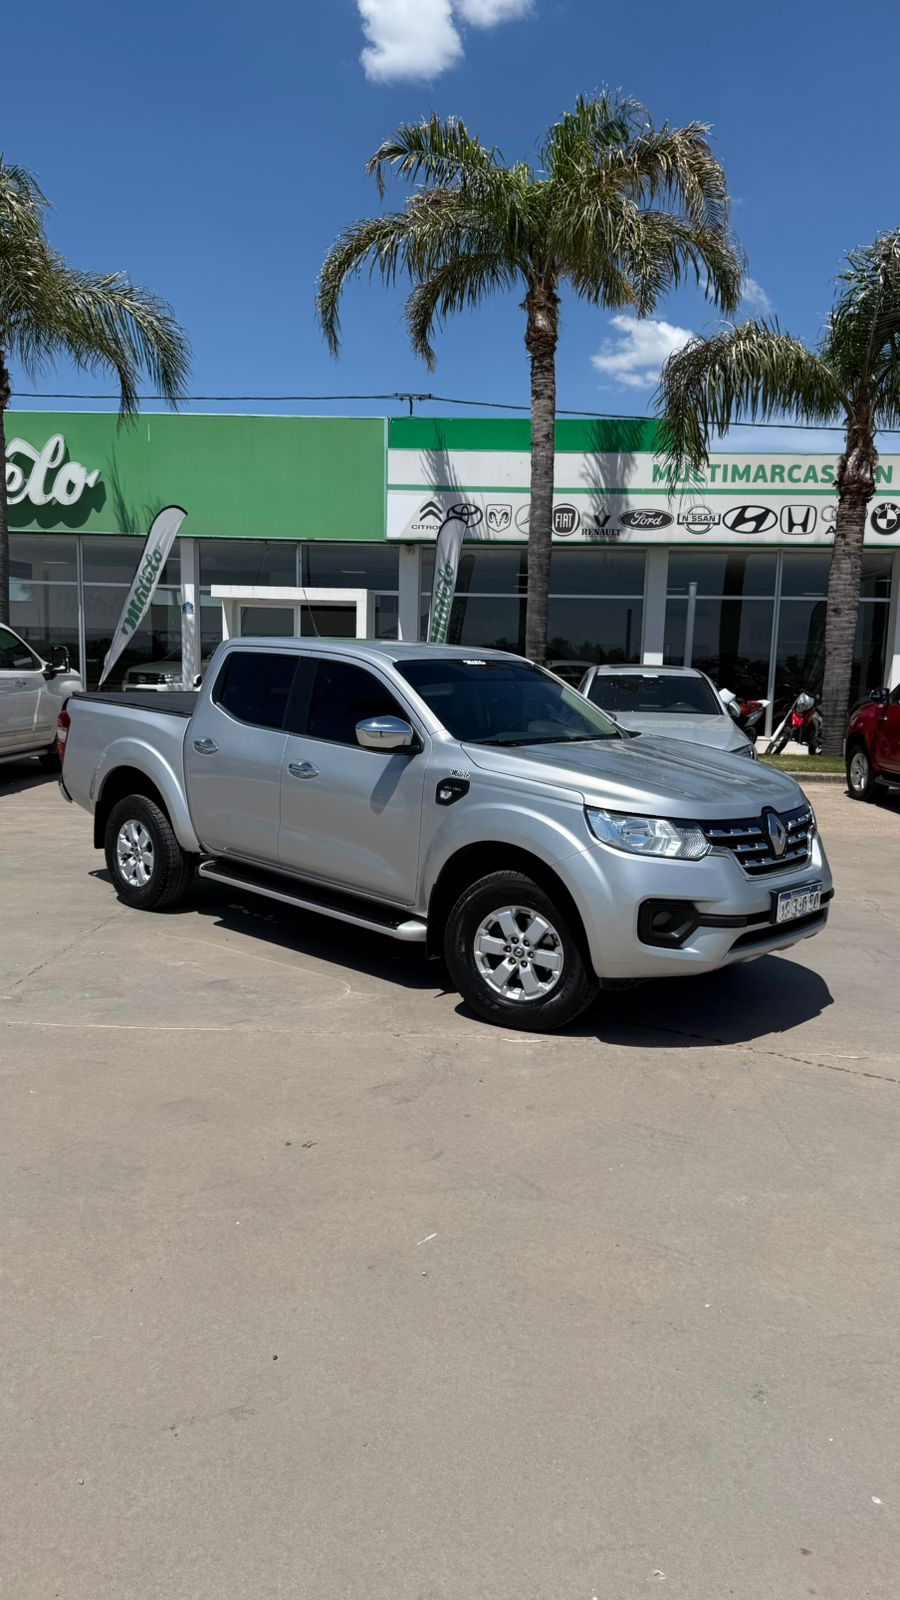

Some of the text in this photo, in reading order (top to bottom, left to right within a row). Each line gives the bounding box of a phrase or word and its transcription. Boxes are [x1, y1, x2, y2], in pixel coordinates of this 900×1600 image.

[5, 433, 100, 506] elo
[652, 463, 836, 484] MULTIMARCAS
[555, 512, 574, 529] FIAT
[630, 510, 662, 526] Ford
[581, 528, 620, 536] RENAULT
